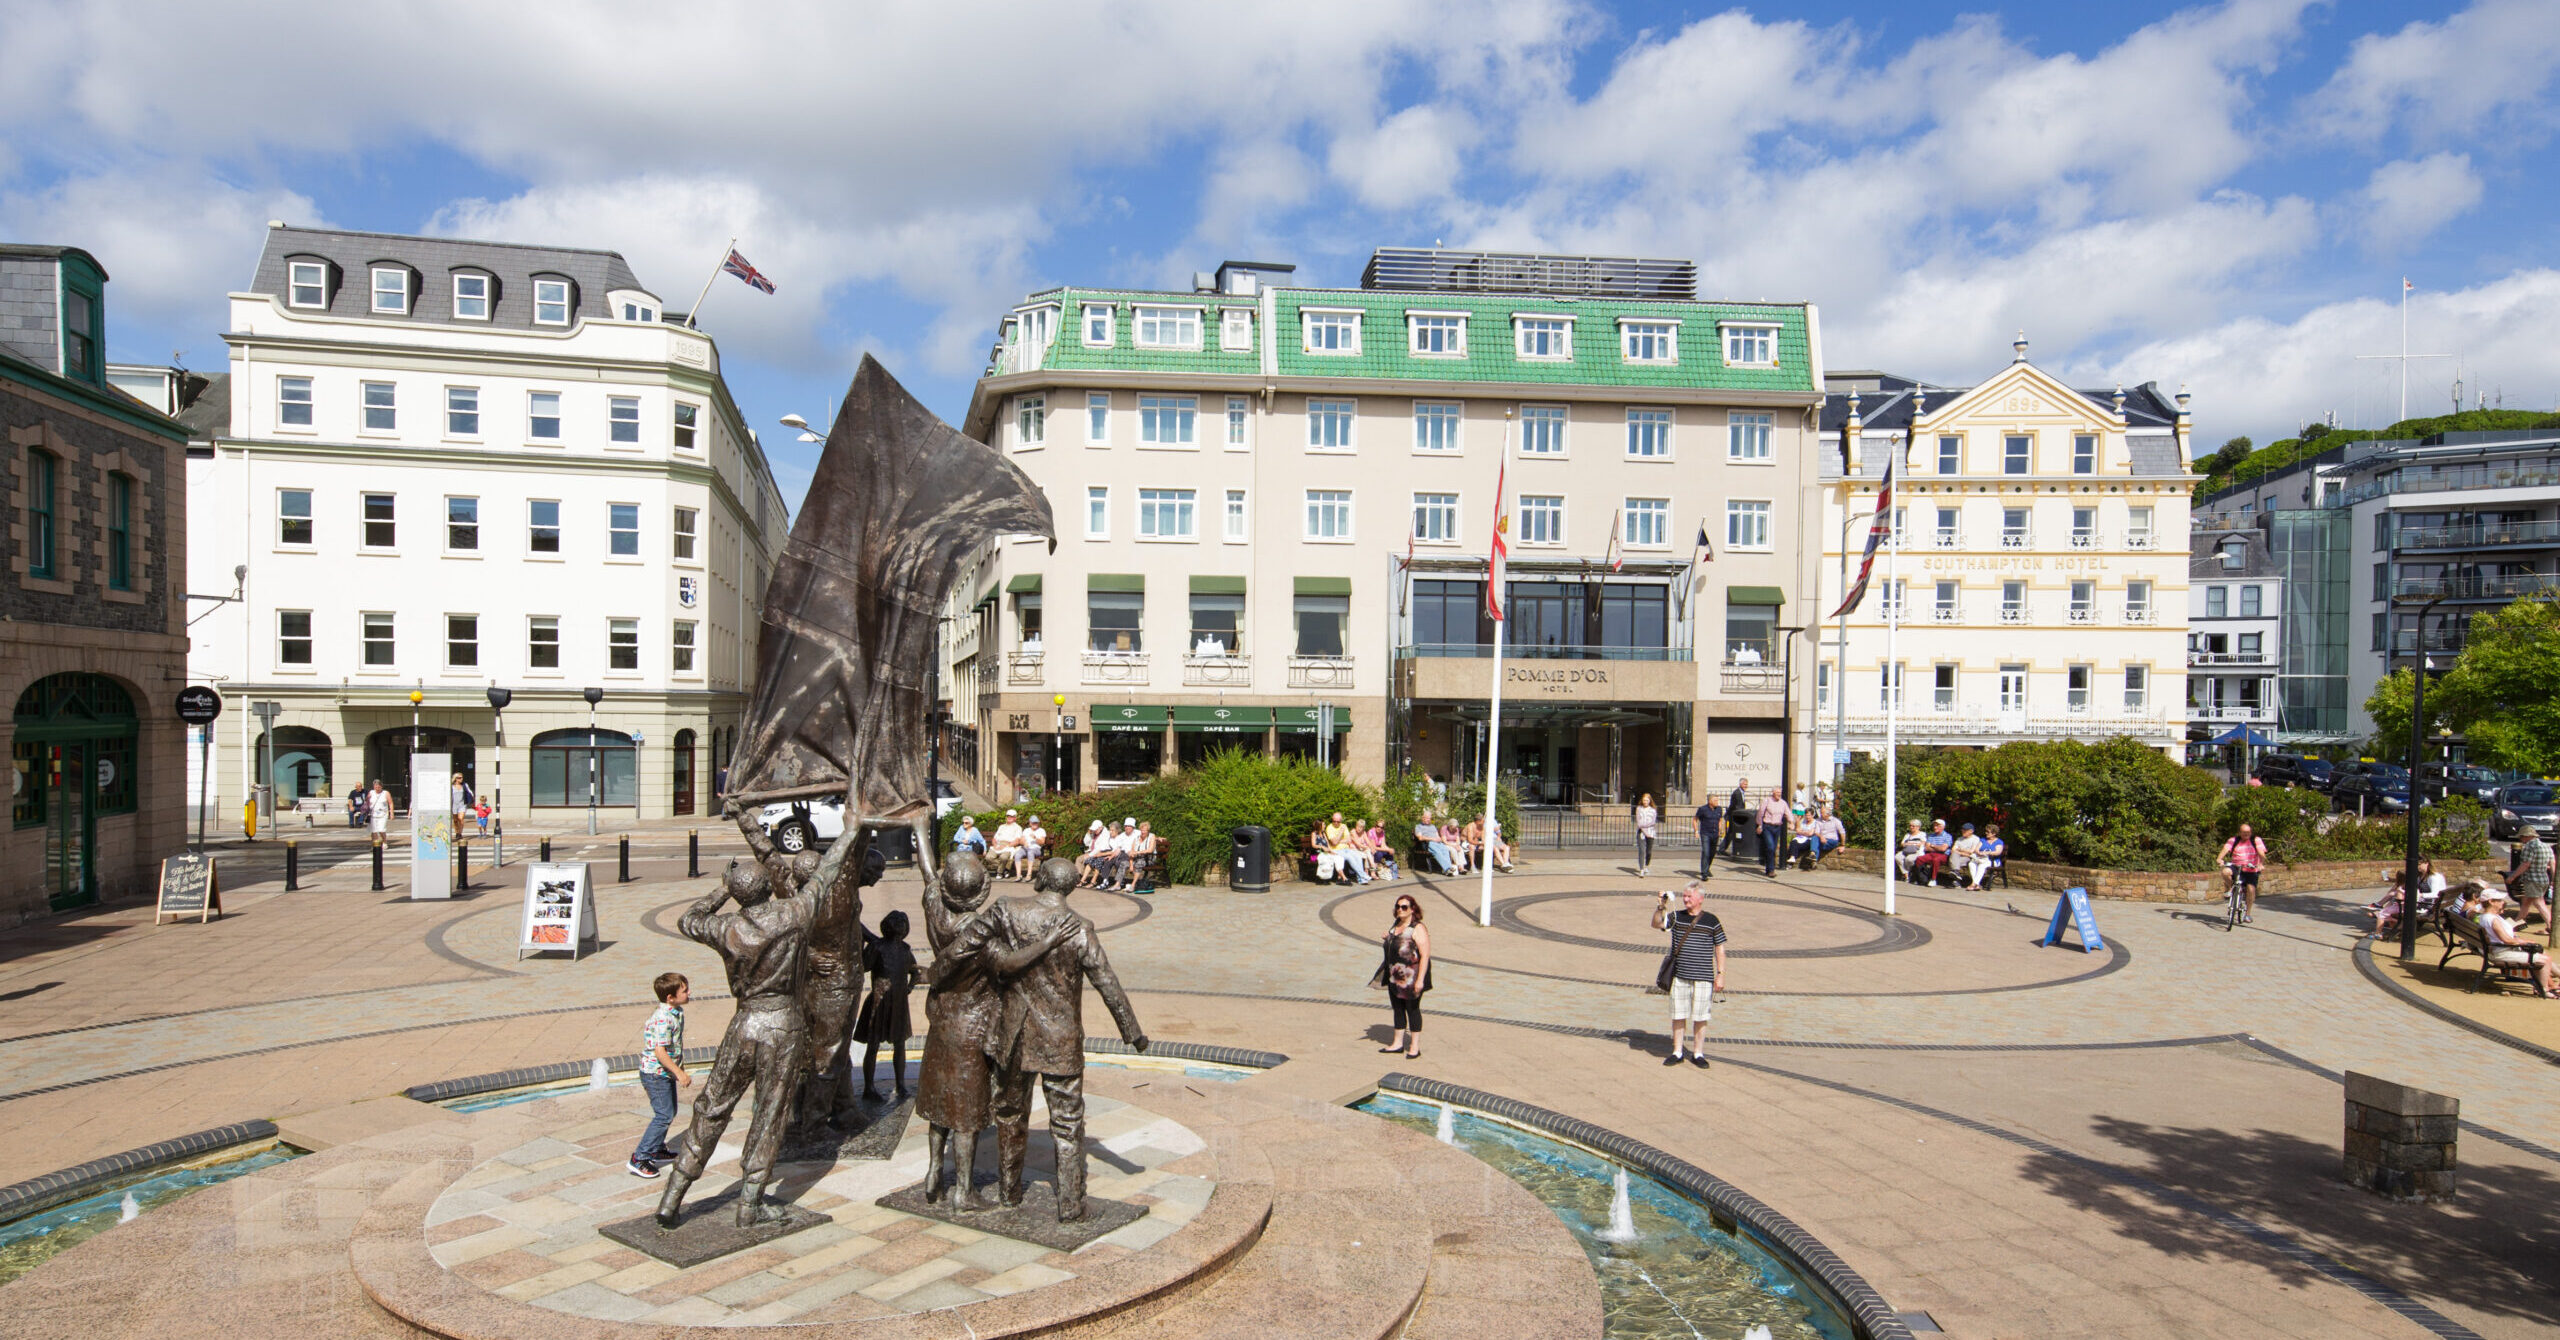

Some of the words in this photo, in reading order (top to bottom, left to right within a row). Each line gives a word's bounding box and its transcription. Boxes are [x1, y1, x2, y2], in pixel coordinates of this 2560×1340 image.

[1923, 557, 2044, 571] SOUTHAMPTON
[2055, 558, 2109, 571] HOTEL
[1508, 667, 1565, 682] POMME
[1570, 669, 1608, 683] D'OR
[1009, 721, 1030, 730] BAR
